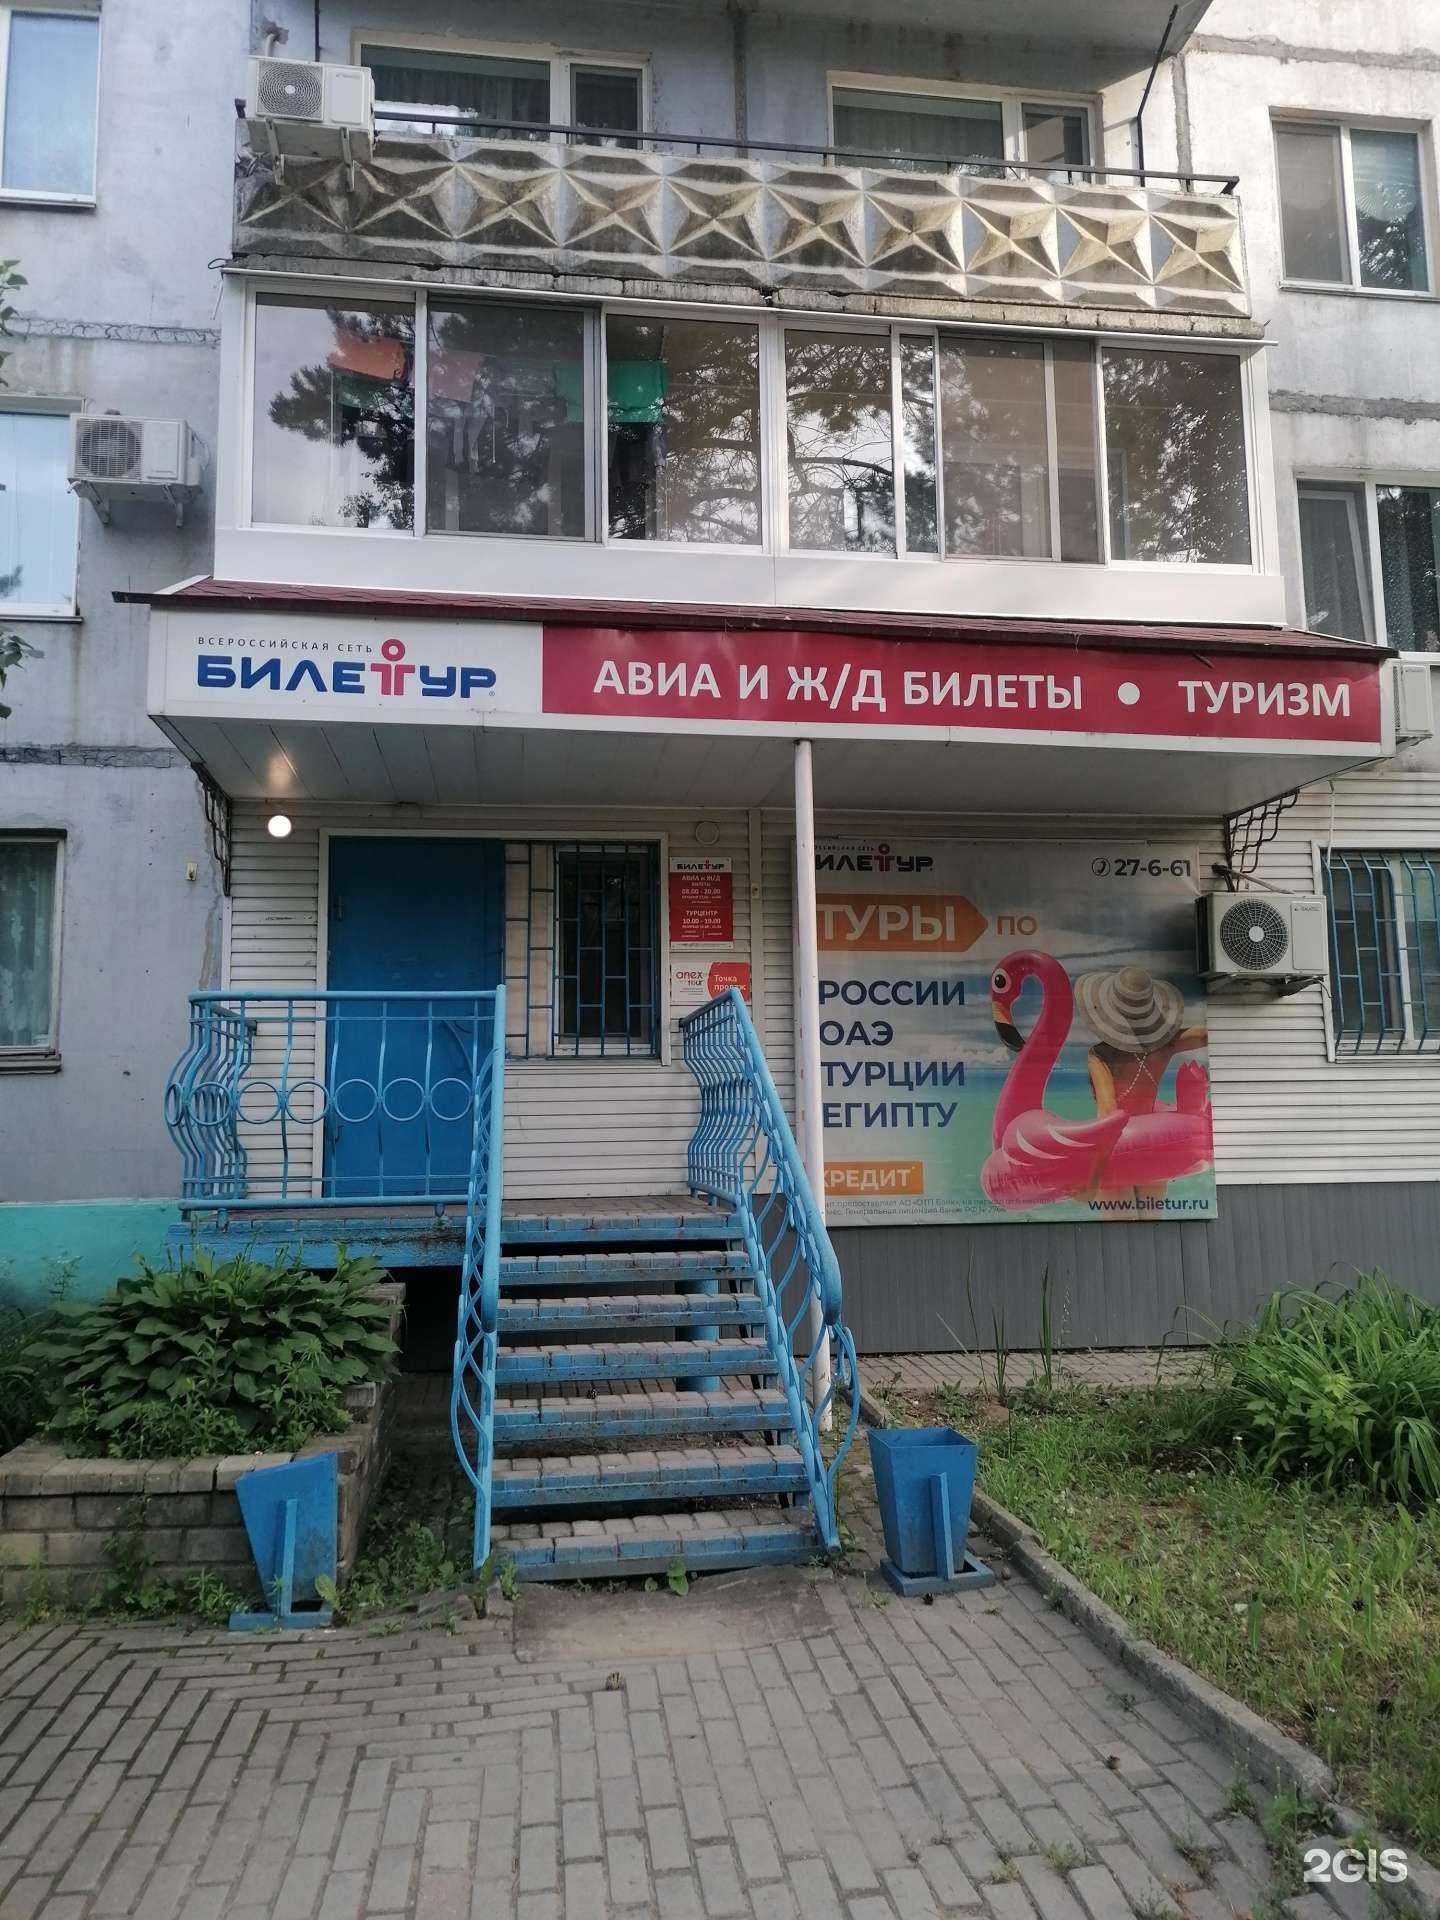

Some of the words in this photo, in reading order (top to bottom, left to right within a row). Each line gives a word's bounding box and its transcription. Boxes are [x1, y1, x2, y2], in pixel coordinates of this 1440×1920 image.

[198, 637, 330, 651] ВСЕРОССИЙСКАЯ
[337, 643, 373, 653] СЕТЬ
[593, 660, 722, 698] АВИА
[739, 664, 768, 700] И
[786, 663, 887, 713] Ж/Д
[903, 671, 1083, 710] БИЛЕТЫ
[1178, 680, 1351, 717] ТУРИЗМ
[815, 843, 934, 872] ИЛЕТУР
[1114, 858, 1191, 877] 27-6-61
[817, 905, 956, 941] ТУРЫ
[997, 916, 1038, 935] ПО
[676, 970, 703, 979] anex
[714, 974, 737, 982] Точка
[819, 980, 966, 1006] РОССИИ
[820, 1020, 894, 1046] ОАЭ
[821, 1061, 965, 1091] ТУРЦИИ
[823, 1102, 959, 1128] ЕГИПТУ
[1088, 1196, 1209, 1210] www.biletur.ru
